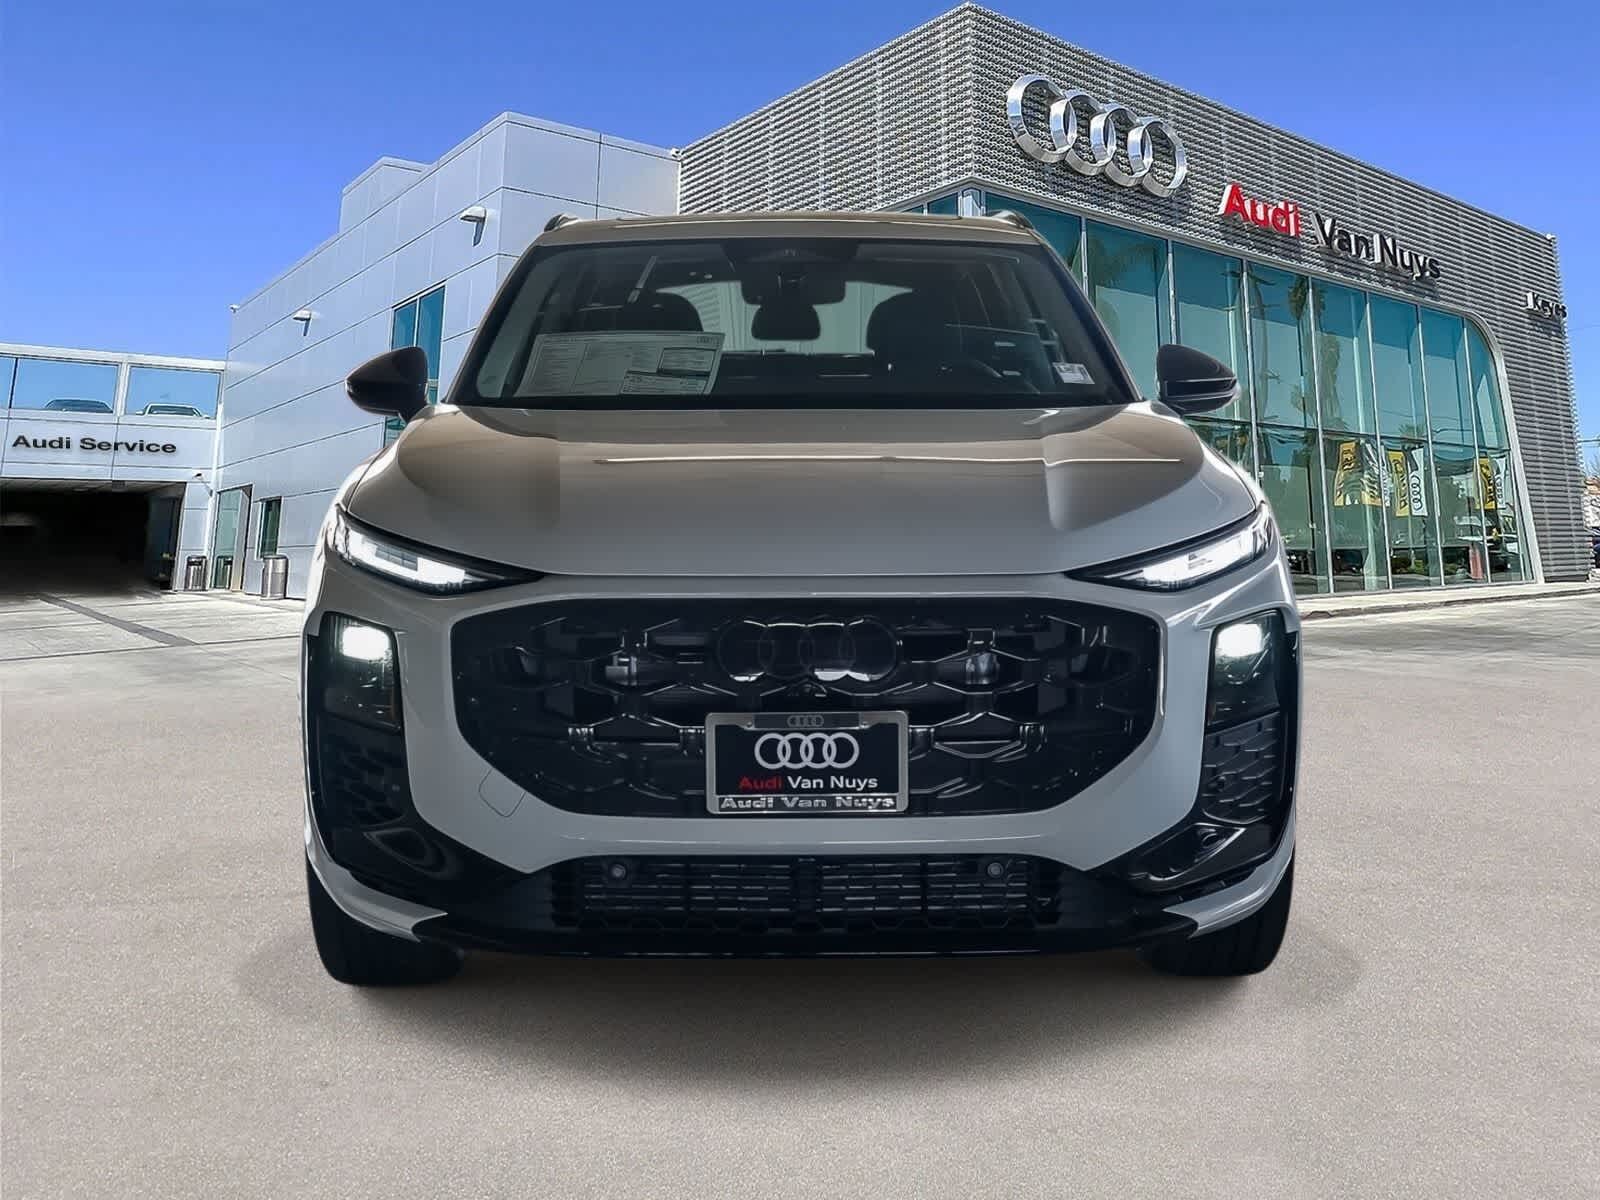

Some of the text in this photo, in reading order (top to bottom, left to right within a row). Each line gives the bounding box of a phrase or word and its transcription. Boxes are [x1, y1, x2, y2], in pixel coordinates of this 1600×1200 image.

[1219, 182, 1442, 281] Audi Van Nuys
[1526, 291, 1568, 318] Keyes
[12, 435, 177, 454] Audi Service
[739, 775, 878, 791] Audi Van Nuys
[721, 796, 896, 810] Audi Van Nuys
